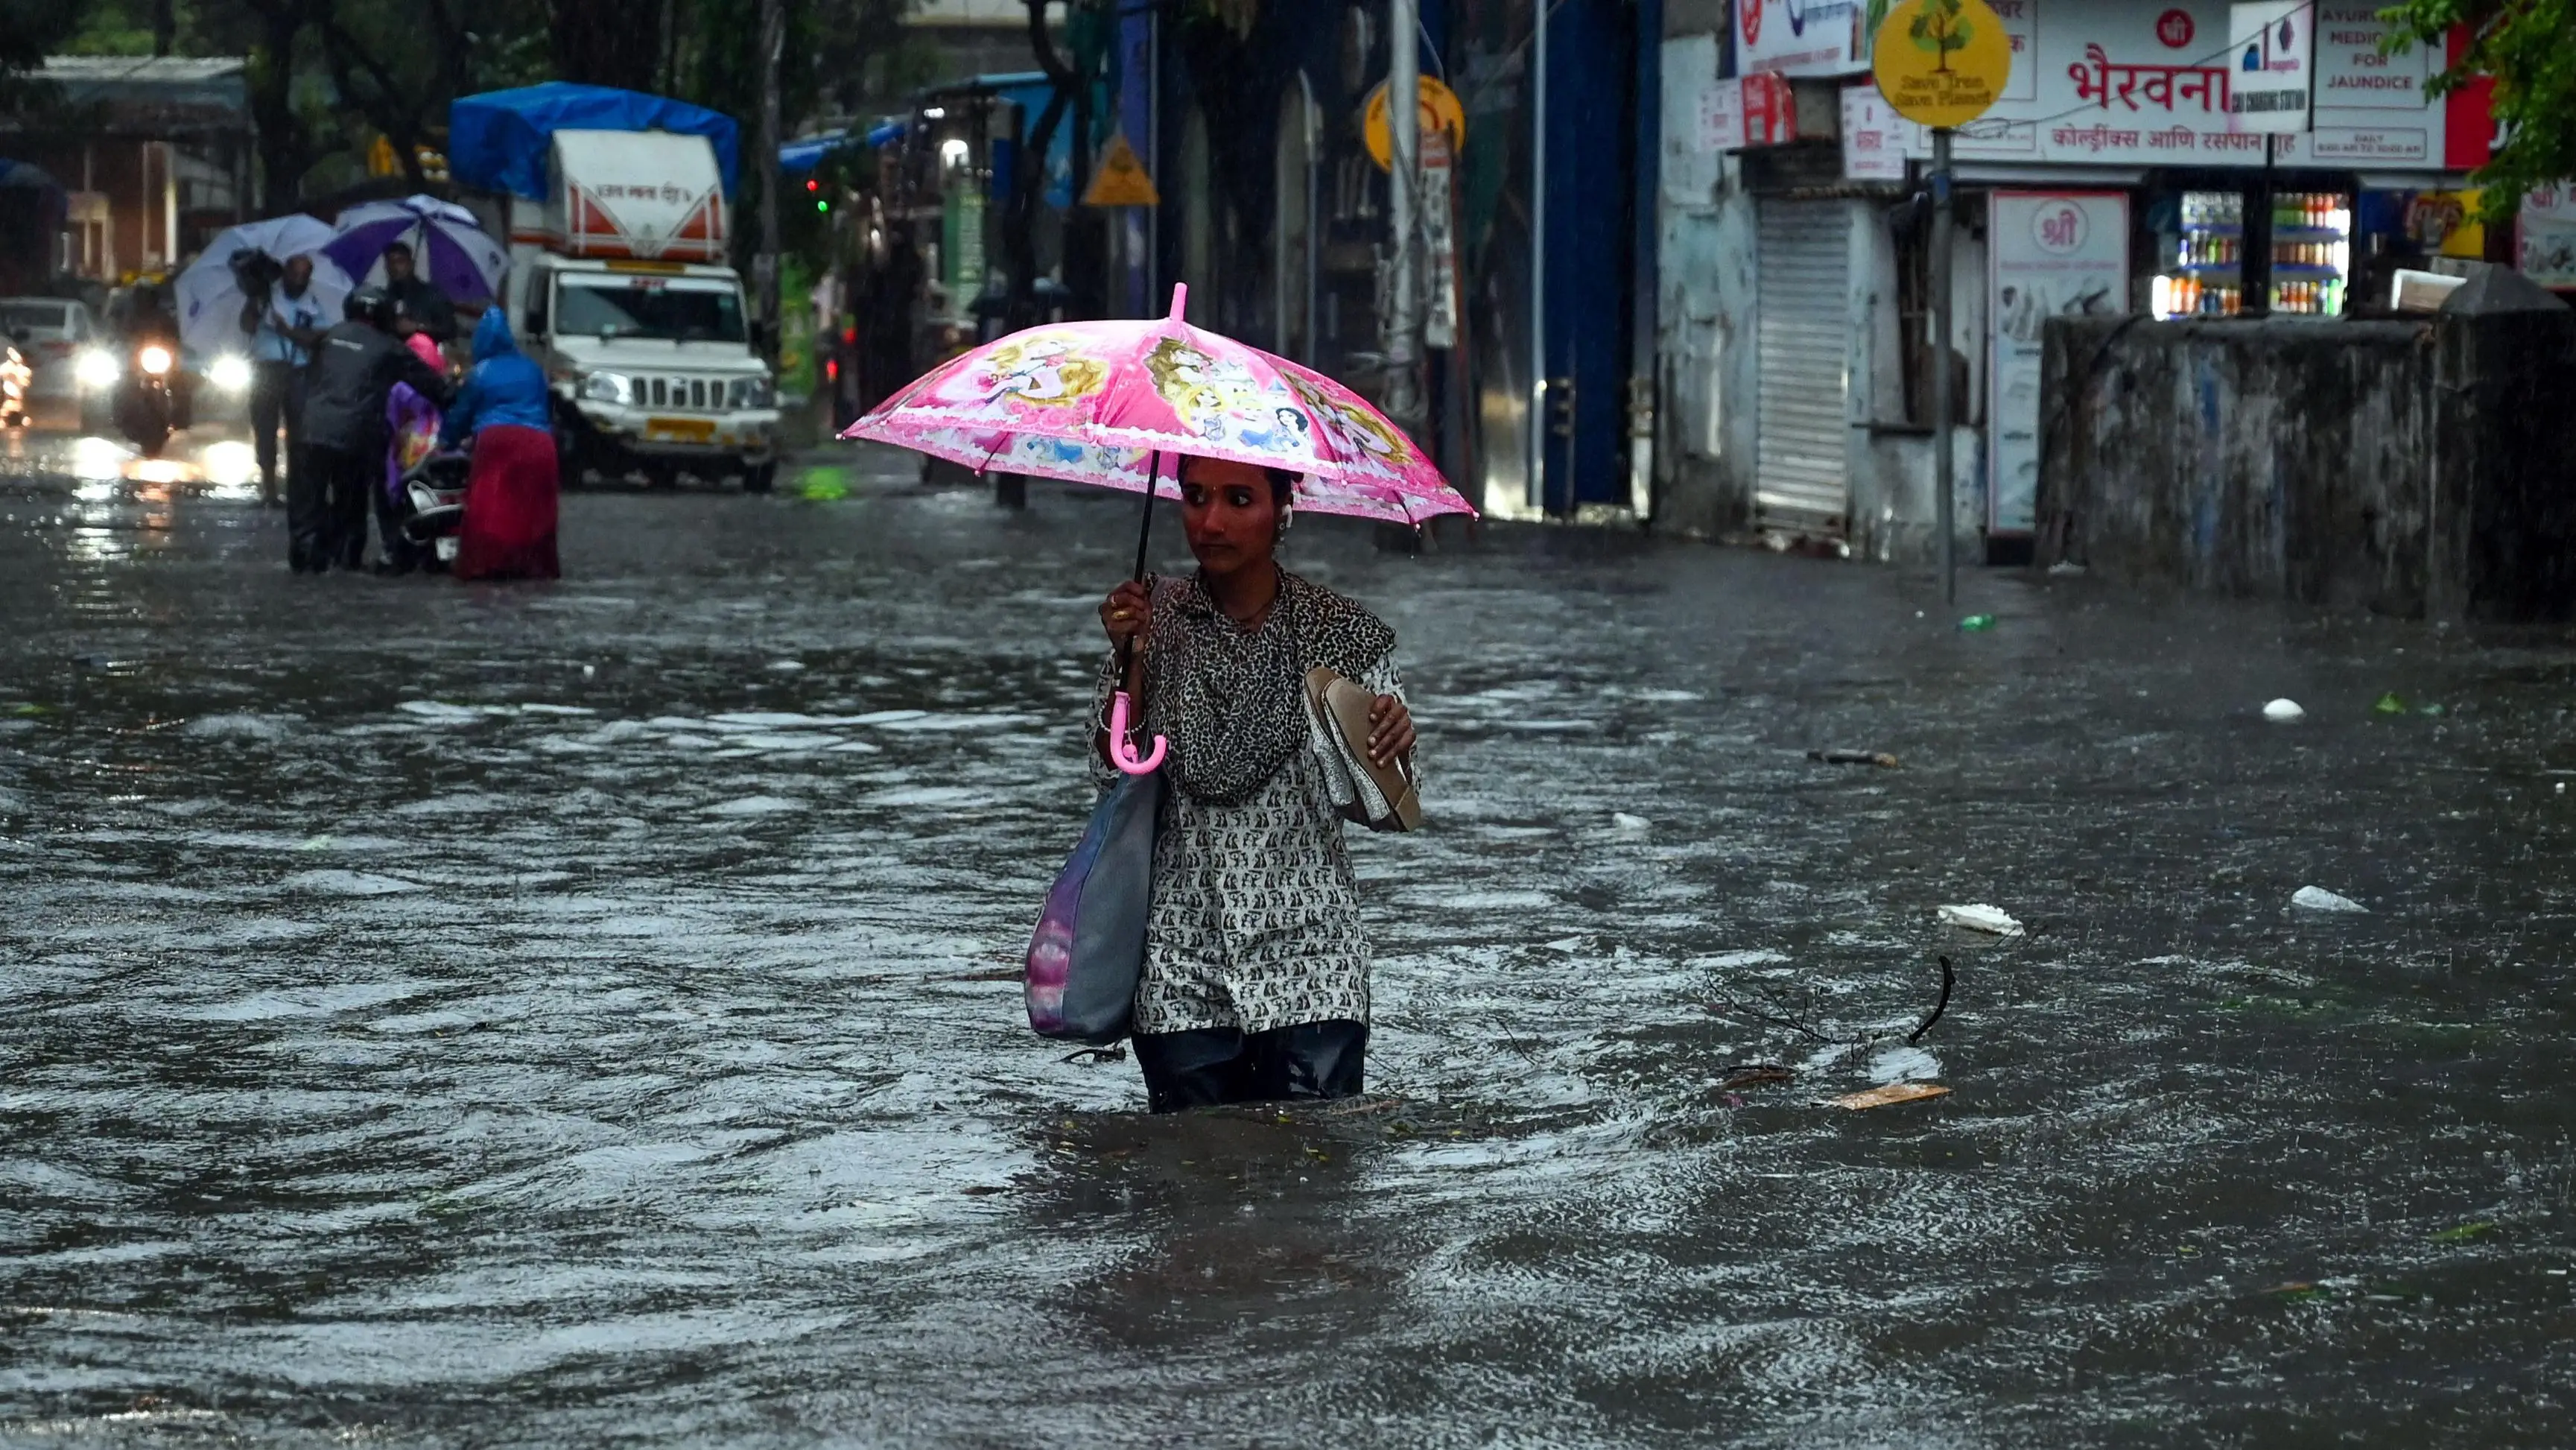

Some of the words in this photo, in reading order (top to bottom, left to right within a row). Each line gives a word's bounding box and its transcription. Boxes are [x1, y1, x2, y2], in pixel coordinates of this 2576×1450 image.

[2353, 52, 2388, 67] FOR
[1900, 75, 1938, 89] Save
[2067, 41, 2230, 112] भैरवना
[2328, 75, 2414, 90] JAUNDICE
[1894, 92, 1934, 106] Save
[1938, 90, 1991, 106] Planet
[2148, 124, 2196, 150] आणि
[2202, 133, 2262, 152] रसपान
[2354, 134, 2385, 143] DAILY
[2041, 209, 2079, 246] श्री
